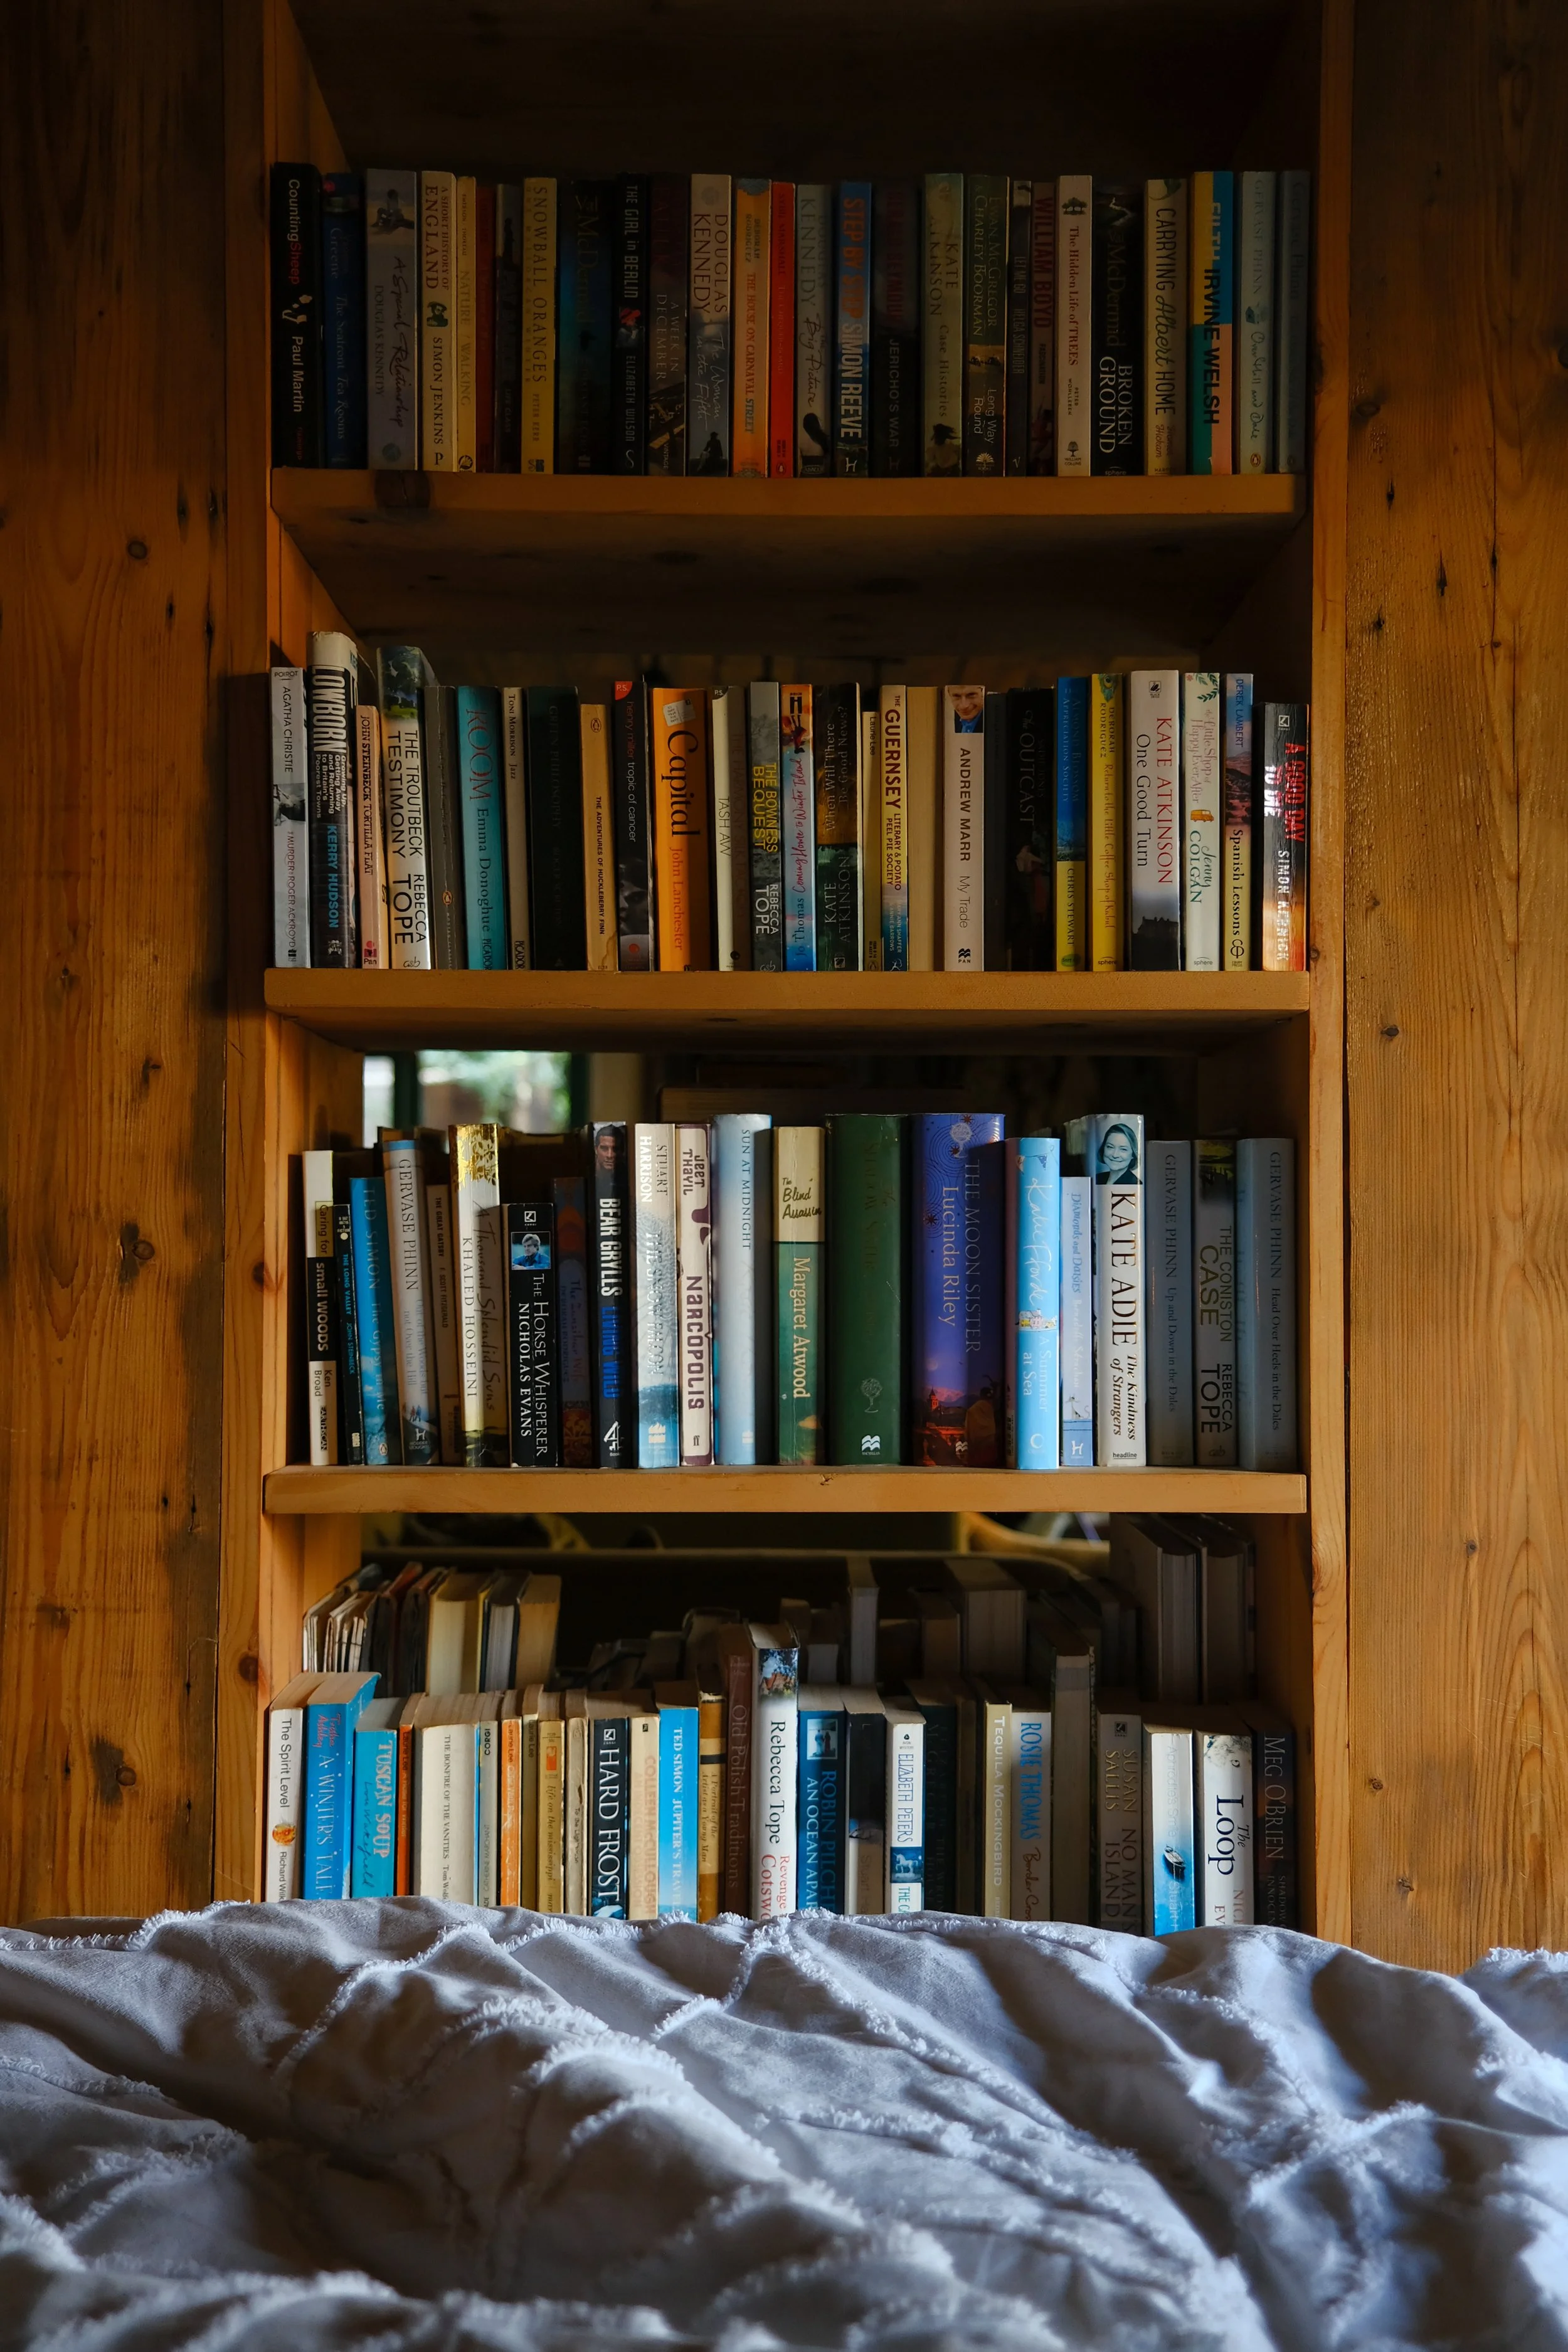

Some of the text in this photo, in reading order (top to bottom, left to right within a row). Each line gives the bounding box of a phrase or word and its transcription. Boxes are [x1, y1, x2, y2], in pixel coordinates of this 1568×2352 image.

[425, 185, 440, 289] ENGLAND
[442, 278, 448, 290] OF
[532, 187, 547, 383] SNOWBALL ORANGES
[623, 185, 638, 298] THE GIRL in BERLIN
[694, 214, 711, 314] KENNEDY
[714, 215, 728, 313] DOUGLAS
[842, 198, 864, 318] STEP BY STEP
[1034, 197, 1052, 328] WILLIAM BOYD
[1069, 226, 1079, 366] The Hidden Life of TREES
[1154, 208, 1177, 415] CARRYING Albert HOME
[1203, 268, 1221, 424] IRVINE WELSH
[292, 336, 304, 412] Paul Martin
[430, 337, 443, 445] SIMON JENKINS
[744, 273, 756, 434] THE HOUSE ON CARNAVAL STREET
[840, 323, 863, 438] SIMON REEVE
[973, 397, 985, 434] Round
[985, 389, 997, 443] Long Way
[1099, 356, 1116, 454] GROUND
[1118, 365, 1132, 445] BROKEN
[283, 687, 292, 773] AGATHA CHRISTIE
[312, 667, 346, 753] LOWBORN
[322, 754, 327, 762] to
[885, 709, 901, 809] GUERNSEY
[338, 755, 346, 787] Growing
[360, 715, 373, 876] JOHN STEINBECK TORTILLA FLAT
[387, 730, 405, 859] TESTIMONY
[404, 730, 422, 857] THE TROUTBECK
[661, 730, 701, 837] Capital
[960, 748, 971, 861] ANDREW MARR
[1136, 734, 1151, 867] One Good Turn
[1156, 718, 1173, 884] KATE ATKINSON
[327, 825, 338, 928] KERRY HUDSON
[392, 873, 413, 945] TOPE
[413, 874, 426, 943] REBECCA
[476, 808, 492, 932] Emma Donoghue
[597, 857, 603, 866] OF
[670, 847, 685, 951] John Lanchester
[957, 876, 970, 928] My Trade
[1229, 829, 1245, 936] Spanish Lessons
[741, 1129, 751, 1250] SUN AT MIDNIGHT
[600, 1198, 623, 1297] BEAR GRYLLS
[938, 1186, 960, 1327] Lucinda Riley
[1110, 1190, 1138, 1347] KATE ADIE
[316, 1262, 329, 1351] small WOODS
[789, 1257, 810, 1399] Margaret Atwood
[314, 1370, 324, 1397] Broad
[324, 1370, 333, 1387] Ken
[518, 1302, 532, 1438] NICHOLAS EVANS
[532, 1273, 549, 1456] THE HORSE WHISPERER
[1109, 1358, 1124, 1436] of Strangers
[1125, 1353, 1138, 1441] The Kindness
[1200, 1364, 1221, 1434] TOPE
[1221, 1364, 1233, 1433] REBECCA
[279, 1717, 292, 1808] The Spirit Level
[373, 1740, 393, 1858] TUSCAN SOUP
[443, 1791, 450, 1801] OF
[765, 1720, 786, 1844] Rebecca Tope
[993, 1715, 1006, 1886] TEQUILA MOCKINGBIRD
[1020, 1722, 1042, 1840] ROSIE THOMAS
[1104, 1750, 1120, 1811] SALLIS
[1122, 1749, 1138, 1813] SUSAN
[442, 1822, 450, 1859] VANITIES
[597, 1747, 621, 1901] HARD FROST
[1121, 1828, 1136, 1861] NO
[1207, 1794, 1244, 1875] Loop
[1237, 1824, 1250, 1848] The
[1104, 1841, 1121, 1918] ISLAND
